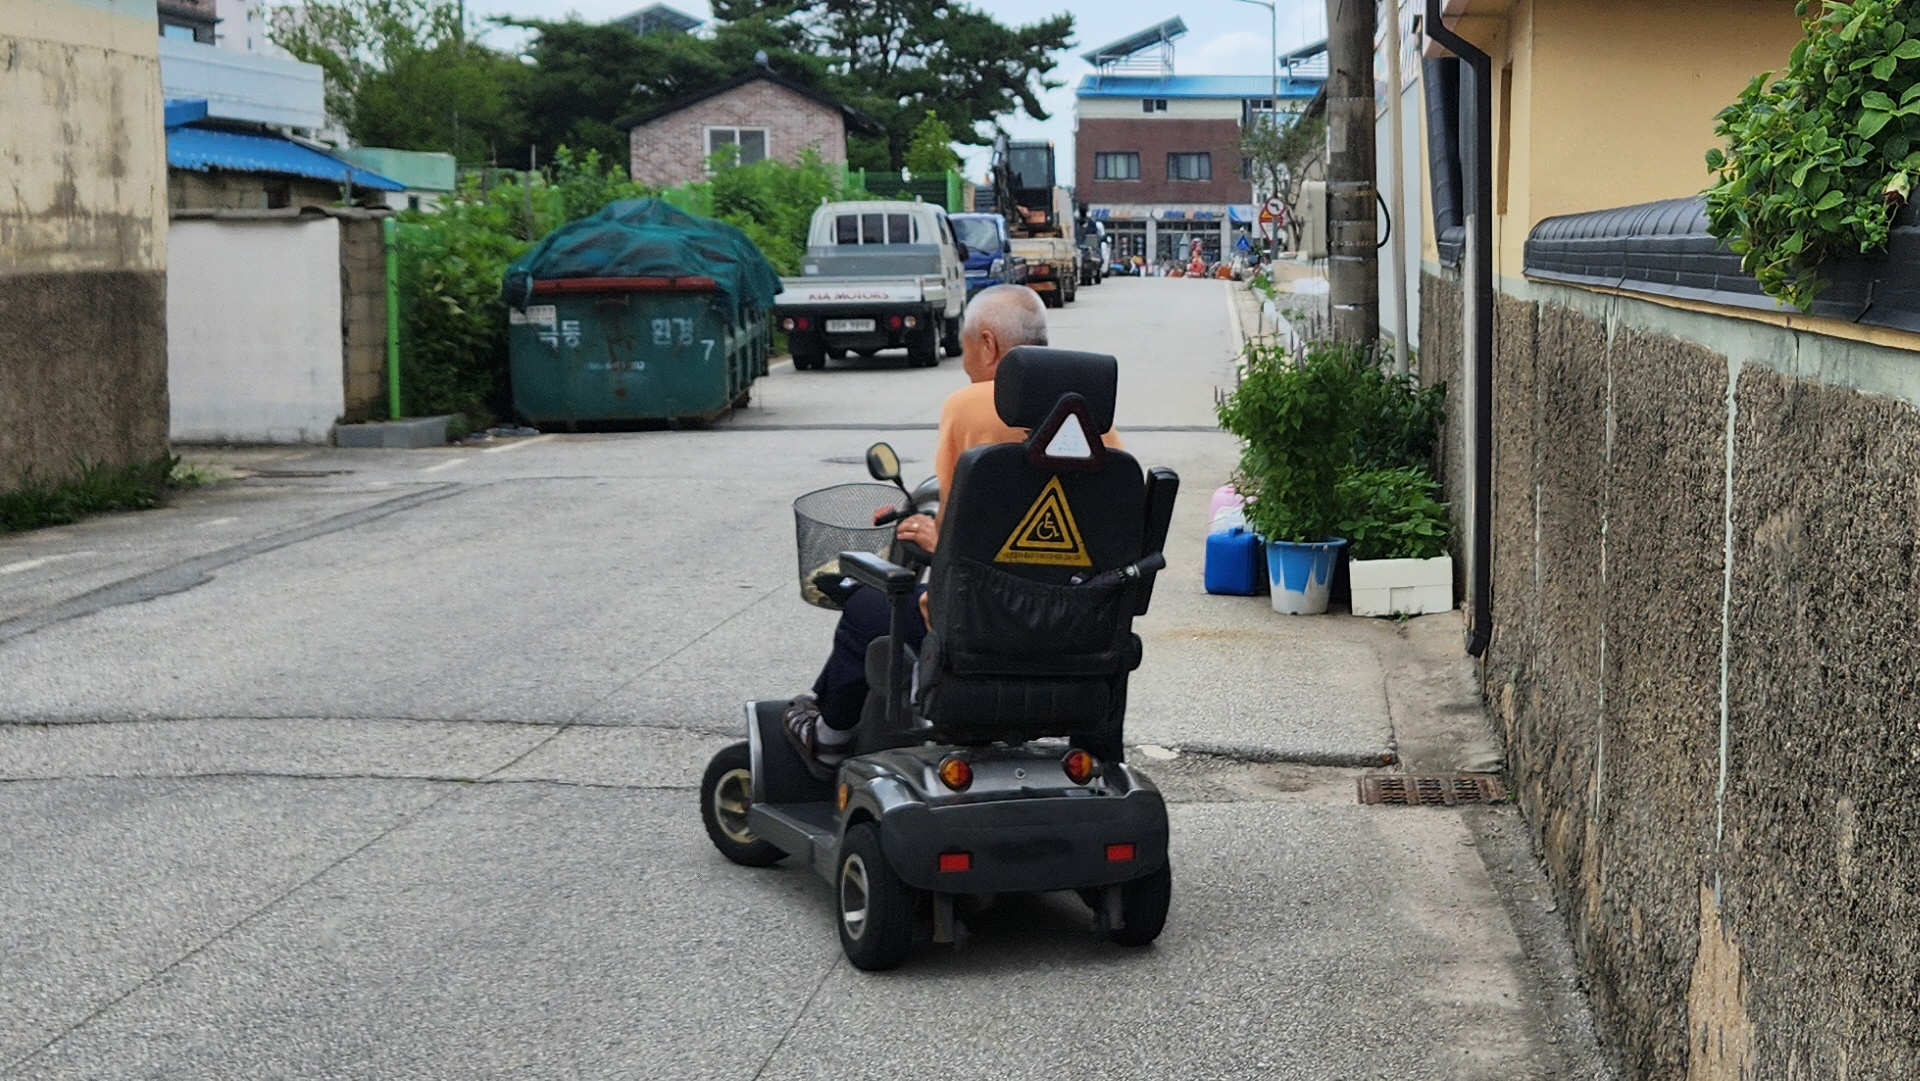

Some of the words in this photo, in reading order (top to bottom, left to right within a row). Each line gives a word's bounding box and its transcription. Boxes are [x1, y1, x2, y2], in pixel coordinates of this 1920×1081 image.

[809, 291, 831, 300] KIA
[834, 290, 889, 300] MOTORS
[701, 339, 715, 361] 7
